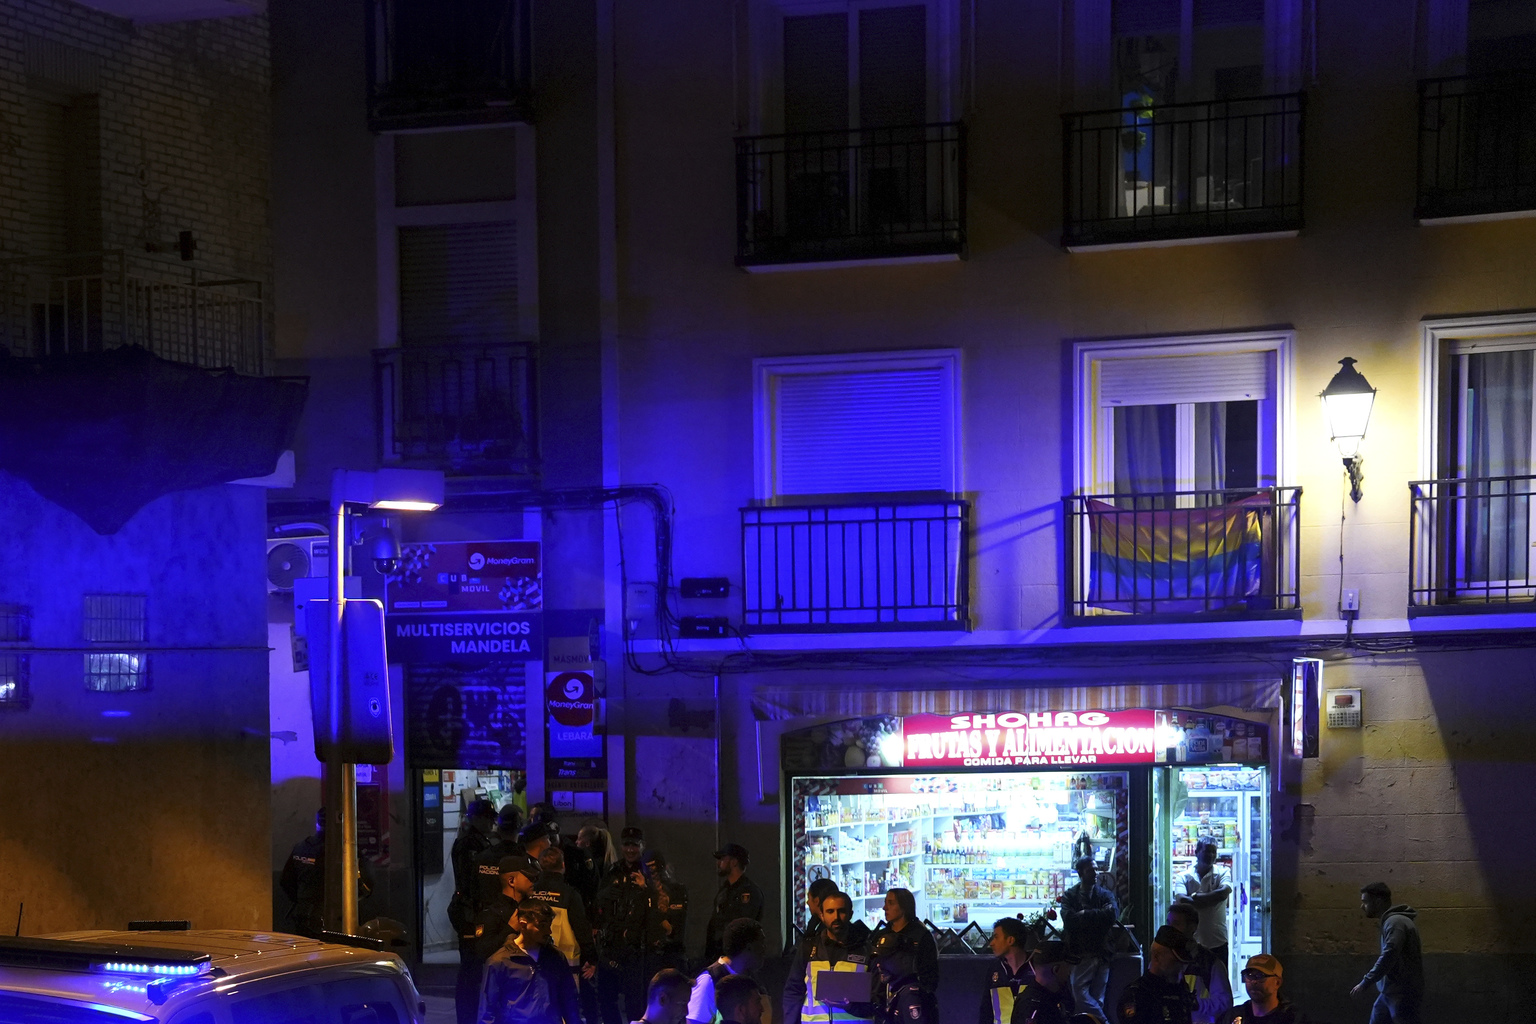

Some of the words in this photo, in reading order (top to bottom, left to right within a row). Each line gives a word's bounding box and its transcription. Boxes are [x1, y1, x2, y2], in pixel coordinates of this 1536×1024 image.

[487, 556, 535, 567] MoneyGram
[396, 621, 531, 638] MULTISERVICIOS
[451, 639, 531, 654] MANDELA
[950, 711, 1111, 730] SHOHAG
[557, 731, 594, 741] LEBARA
[906, 730, 983, 760] FRUTAS
[984, 729, 1002, 758] Y
[1002, 726, 1155, 757] ALIMENTACION
[963, 756, 1013, 767] COMIDA
[1015, 755, 1048, 766] PARA
[1050, 754, 1097, 765] LLEVAR
[553, 799, 572, 807] Libon
